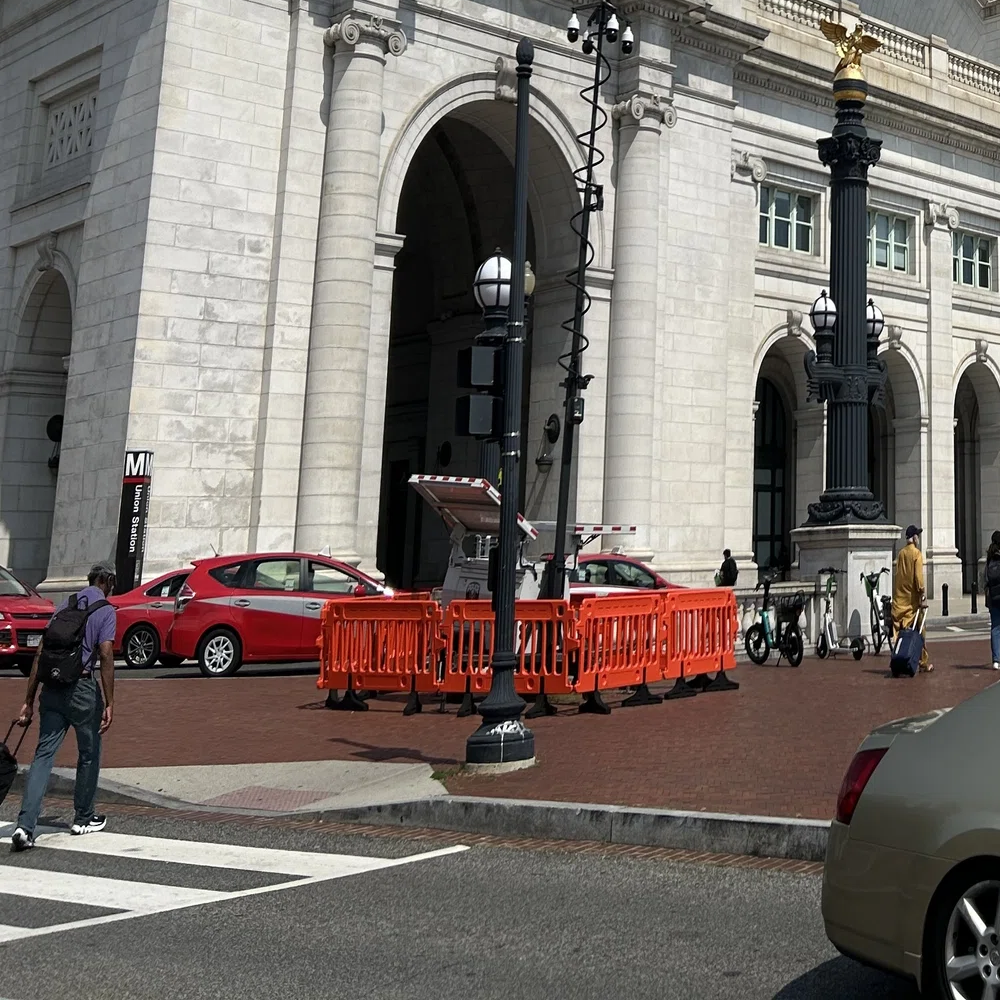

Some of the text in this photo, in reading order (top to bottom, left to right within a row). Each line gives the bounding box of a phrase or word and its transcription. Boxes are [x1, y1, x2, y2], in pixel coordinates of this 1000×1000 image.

[125, 453, 145, 476] M
[133, 485, 142, 513] Union
[129, 516, 140, 553] Station
